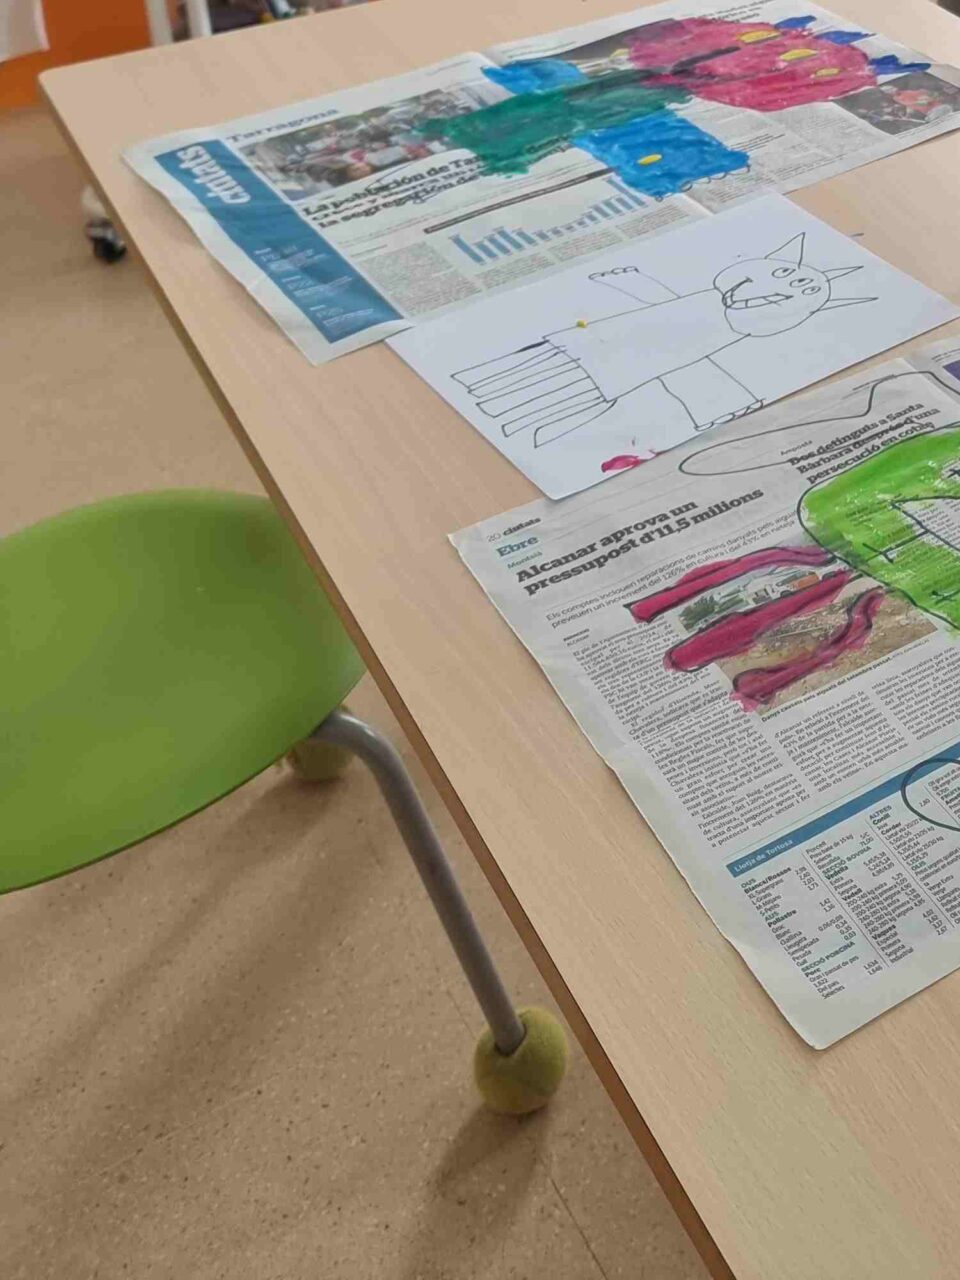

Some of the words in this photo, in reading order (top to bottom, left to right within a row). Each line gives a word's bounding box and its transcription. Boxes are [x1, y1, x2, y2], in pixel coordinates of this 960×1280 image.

[176, 146, 252, 204] ciutats
[813, 421, 882, 454] detinguts
[885, 401, 924, 421] Santa
[802, 443, 885, 484] persecució
[878, 434, 899, 446] en
[495, 534, 540, 557] Ebre
[512, 540, 601, 583] Alcanar
[596, 510, 672, 548] aprova
[669, 500, 698, 517] un
[520, 537, 642, 596] pressupost
[636, 517, 693, 547] d'11,5
[688, 487, 765, 524] milions
[551, 607, 594, 629] preveuen
[604, 583, 649, 606] increment
[558, 595, 600, 617] comptes
[761, 710, 781, 722] Danys
[845, 665, 873, 681] setembre
[871, 655, 894, 669] passat.
[716, 824, 751, 845] potenciar
[733, 856, 758, 873] Llotja
[755, 852, 766, 861] de
[765, 838, 794, 856] Tortosa
[824, 864, 849, 880] Vedella
[841, 887, 863, 902] Vedell
[767, 908, 797, 928] Pollastre
[871, 923, 897, 941] Vaques
